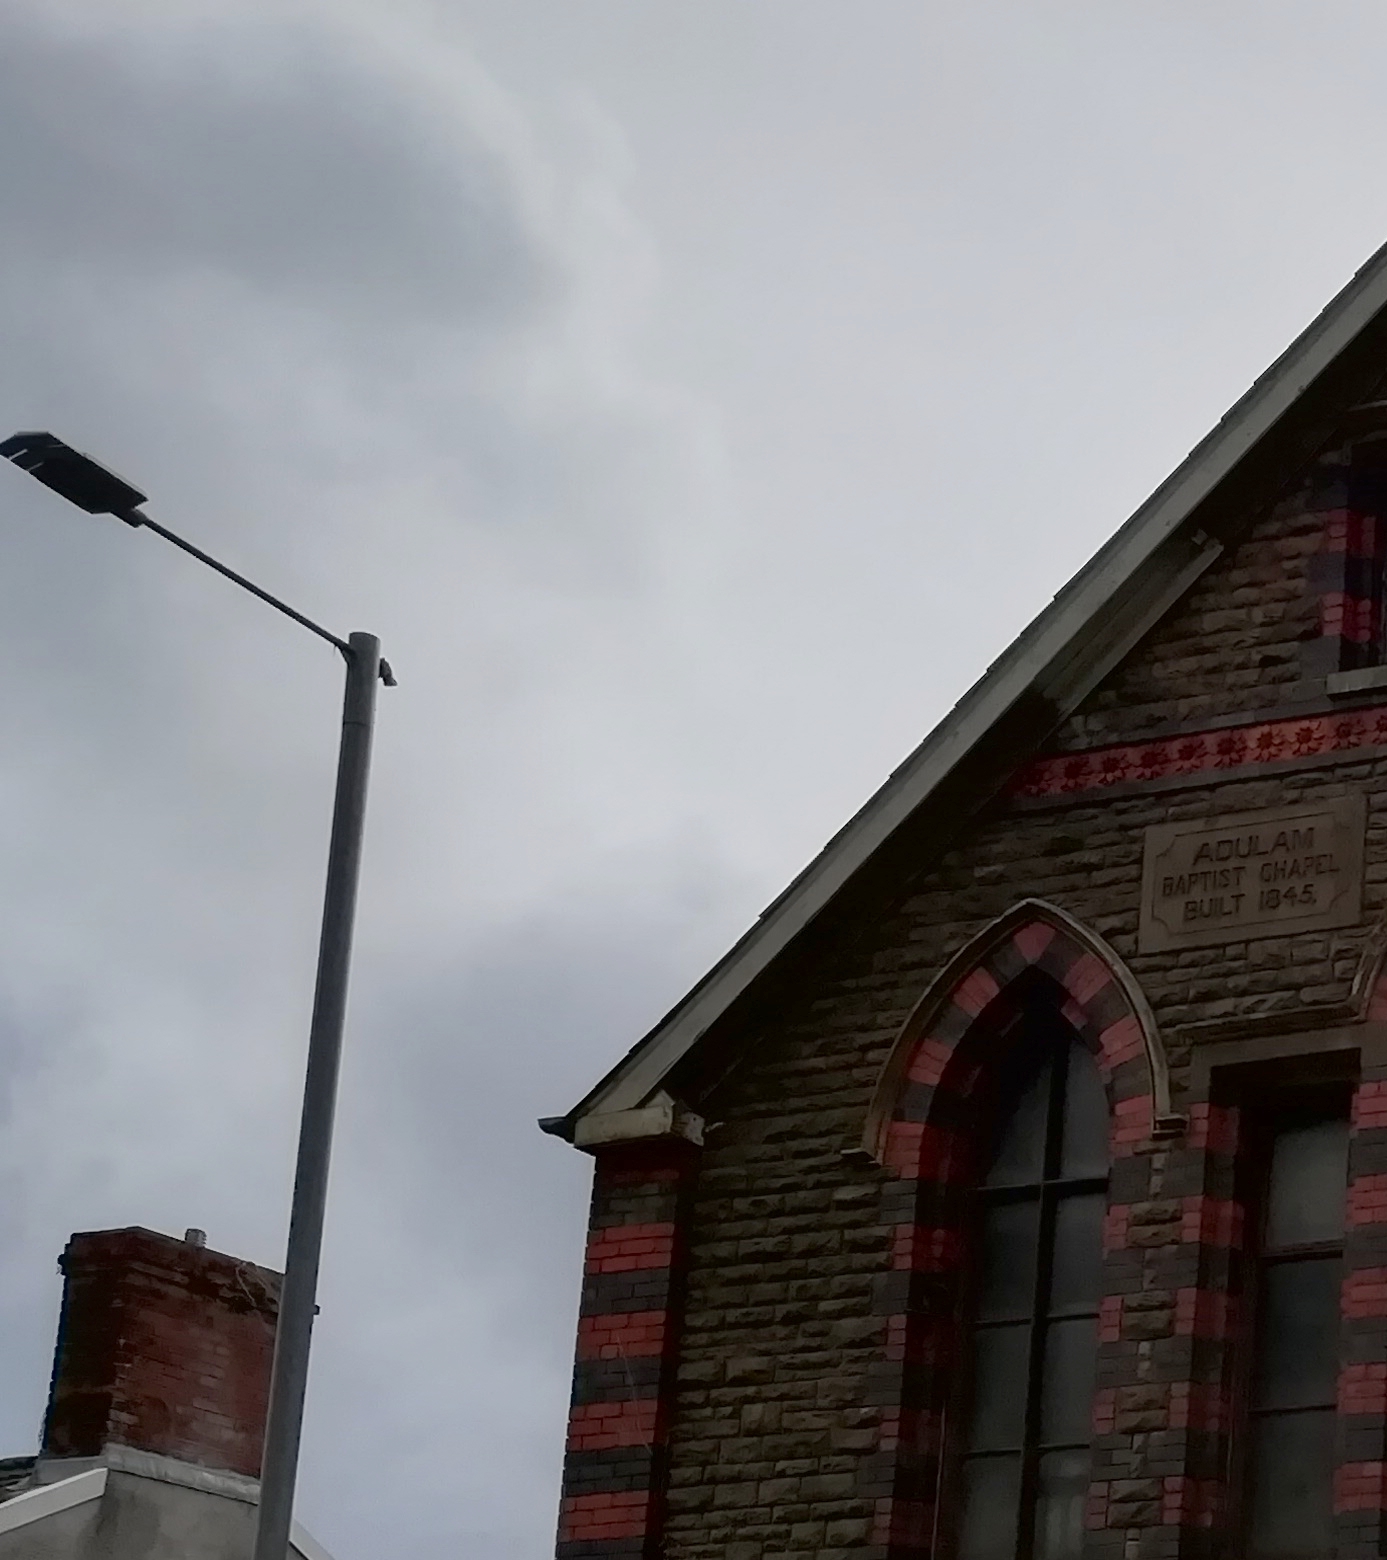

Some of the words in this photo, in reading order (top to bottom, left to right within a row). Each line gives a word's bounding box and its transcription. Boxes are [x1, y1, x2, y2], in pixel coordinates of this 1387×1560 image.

[1192, 827, 1316, 866] ADULAM
[1161, 866, 1246, 897] BAPTIST
[1259, 853, 1341, 883] CHAPEL
[1183, 893, 1246, 921] BUILT
